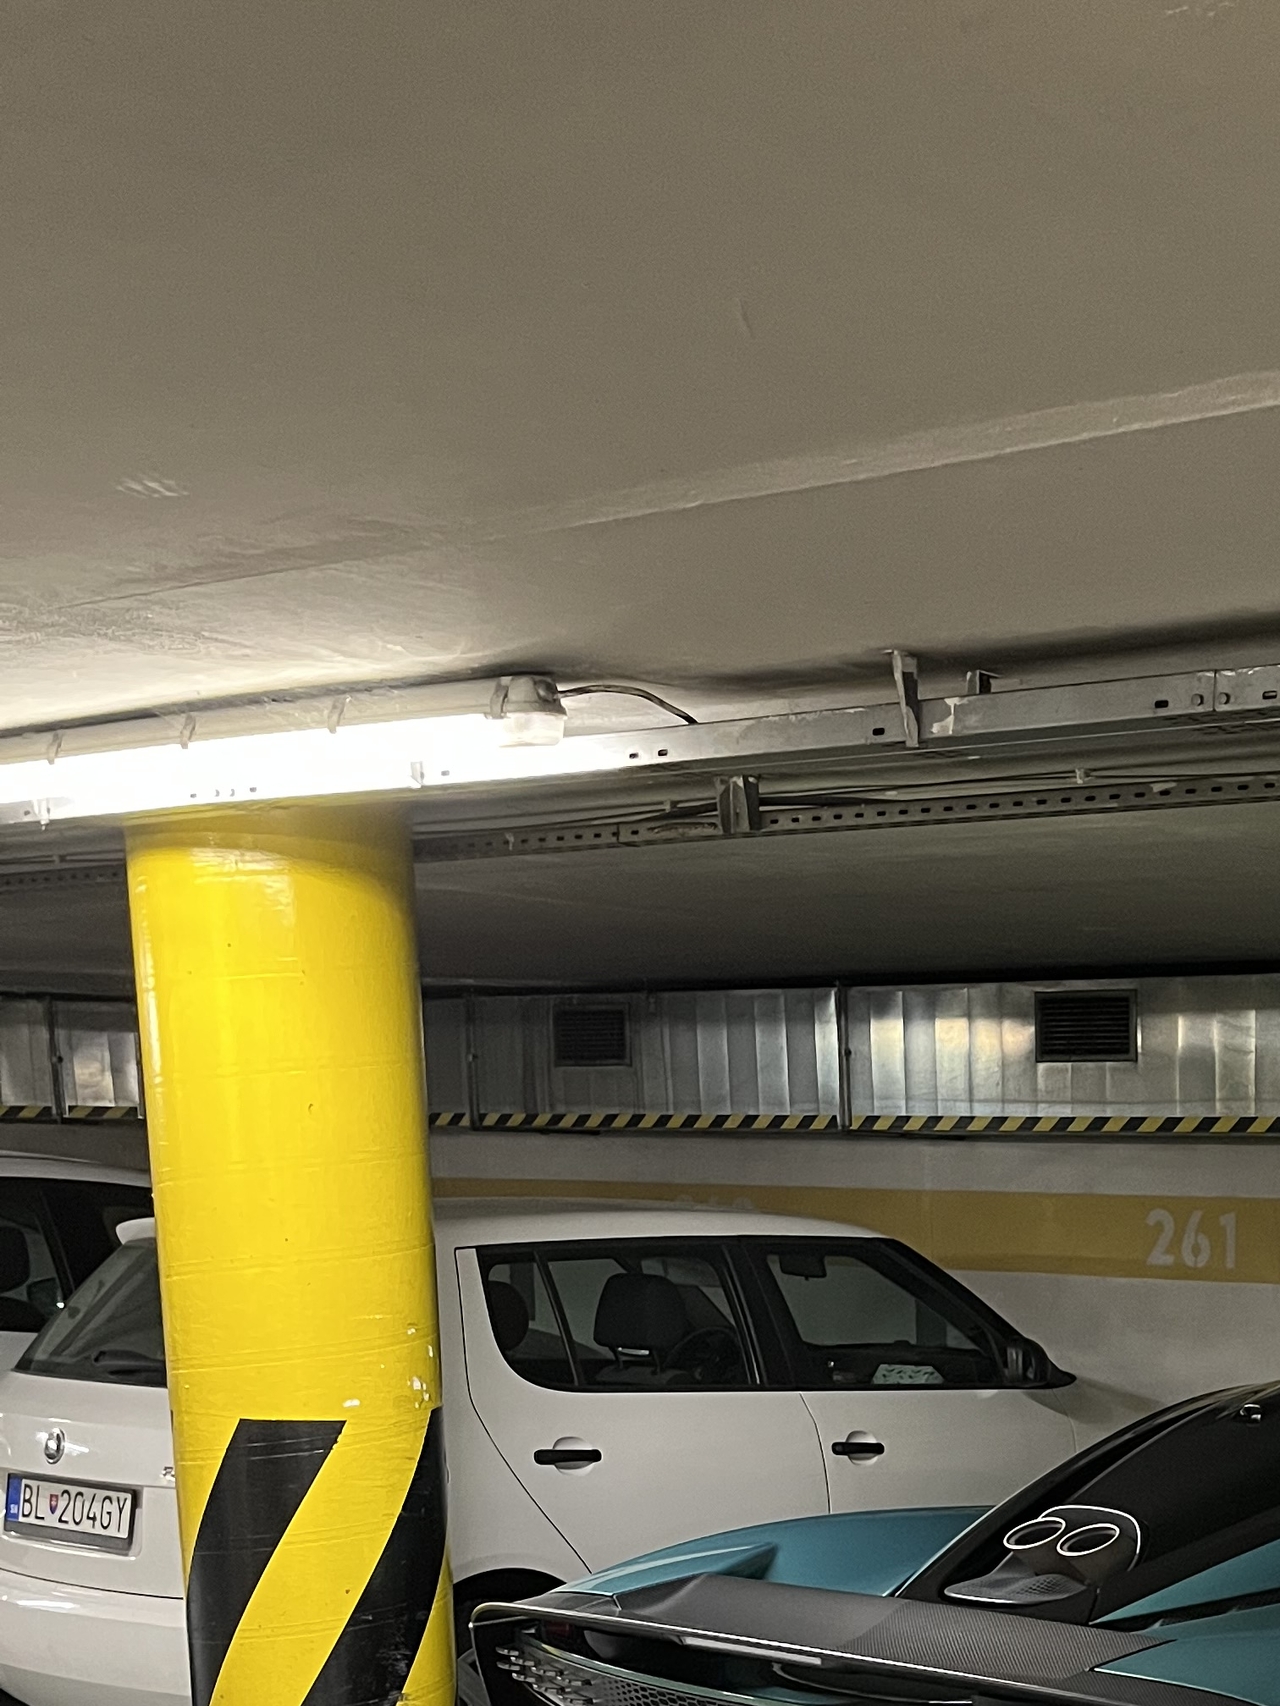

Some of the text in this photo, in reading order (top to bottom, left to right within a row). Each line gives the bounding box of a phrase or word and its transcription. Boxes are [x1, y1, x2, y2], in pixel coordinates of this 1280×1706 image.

[1145, 1208, 1237, 1269] 261
[22, 1483, 128, 1533] BL 204GY
